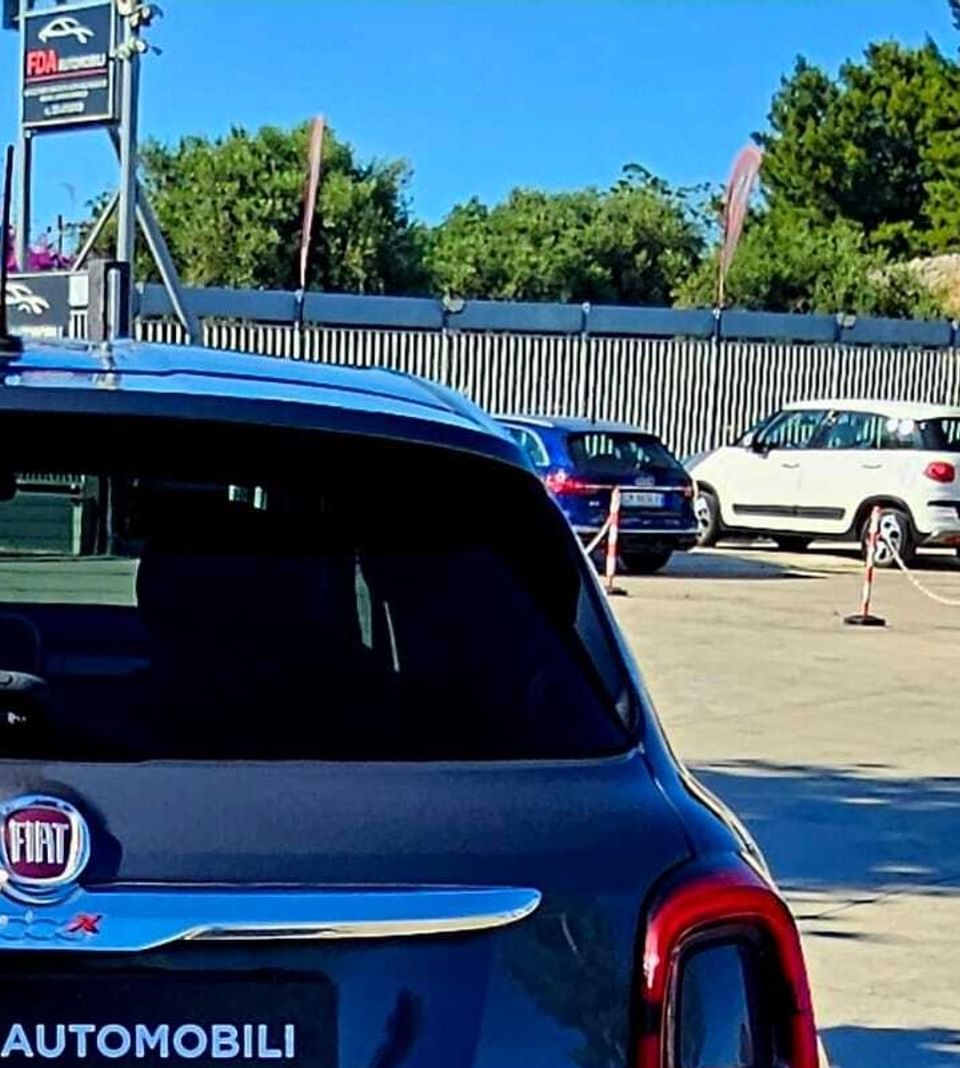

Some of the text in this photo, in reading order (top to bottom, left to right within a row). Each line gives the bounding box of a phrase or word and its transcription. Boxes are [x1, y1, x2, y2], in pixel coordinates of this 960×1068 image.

[27, 49, 57, 75] FDA
[8, 818, 70, 865] FIAT
[1, 1023, 295, 1058] AUTOMOBILI
